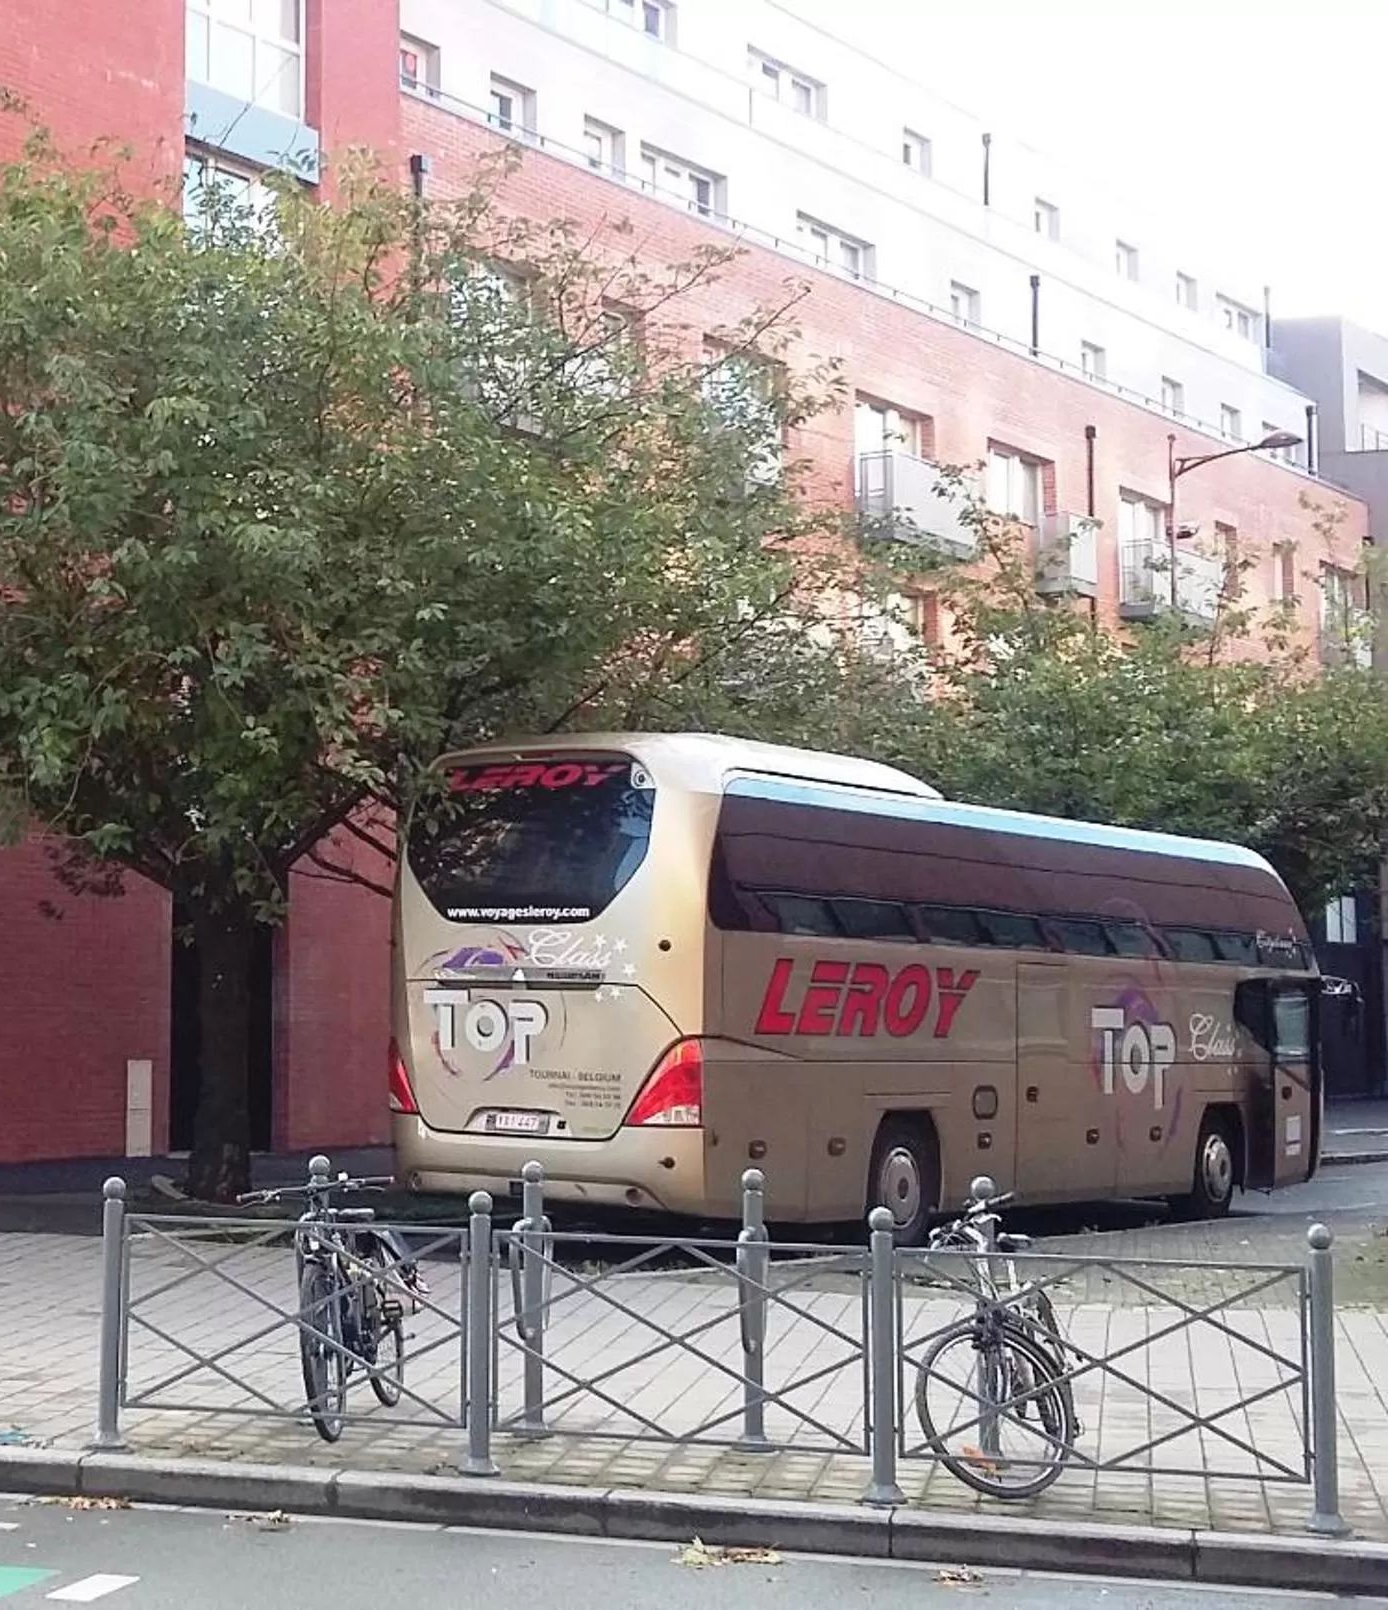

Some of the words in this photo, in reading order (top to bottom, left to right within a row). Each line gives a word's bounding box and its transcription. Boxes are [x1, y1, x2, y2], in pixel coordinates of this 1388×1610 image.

[448, 763, 628, 791] LEROY
[447, 905, 591, 921] www.voyagesleroy.com
[522, 927, 612, 968] Class
[754, 958, 981, 1038] LEROY
[423, 987, 549, 1065] TOP
[529, 1069, 570, 1079] TOURNAI
[577, 1071, 620, 1081] BELGIUM
[1091, 1005, 1176, 1110] TOP
